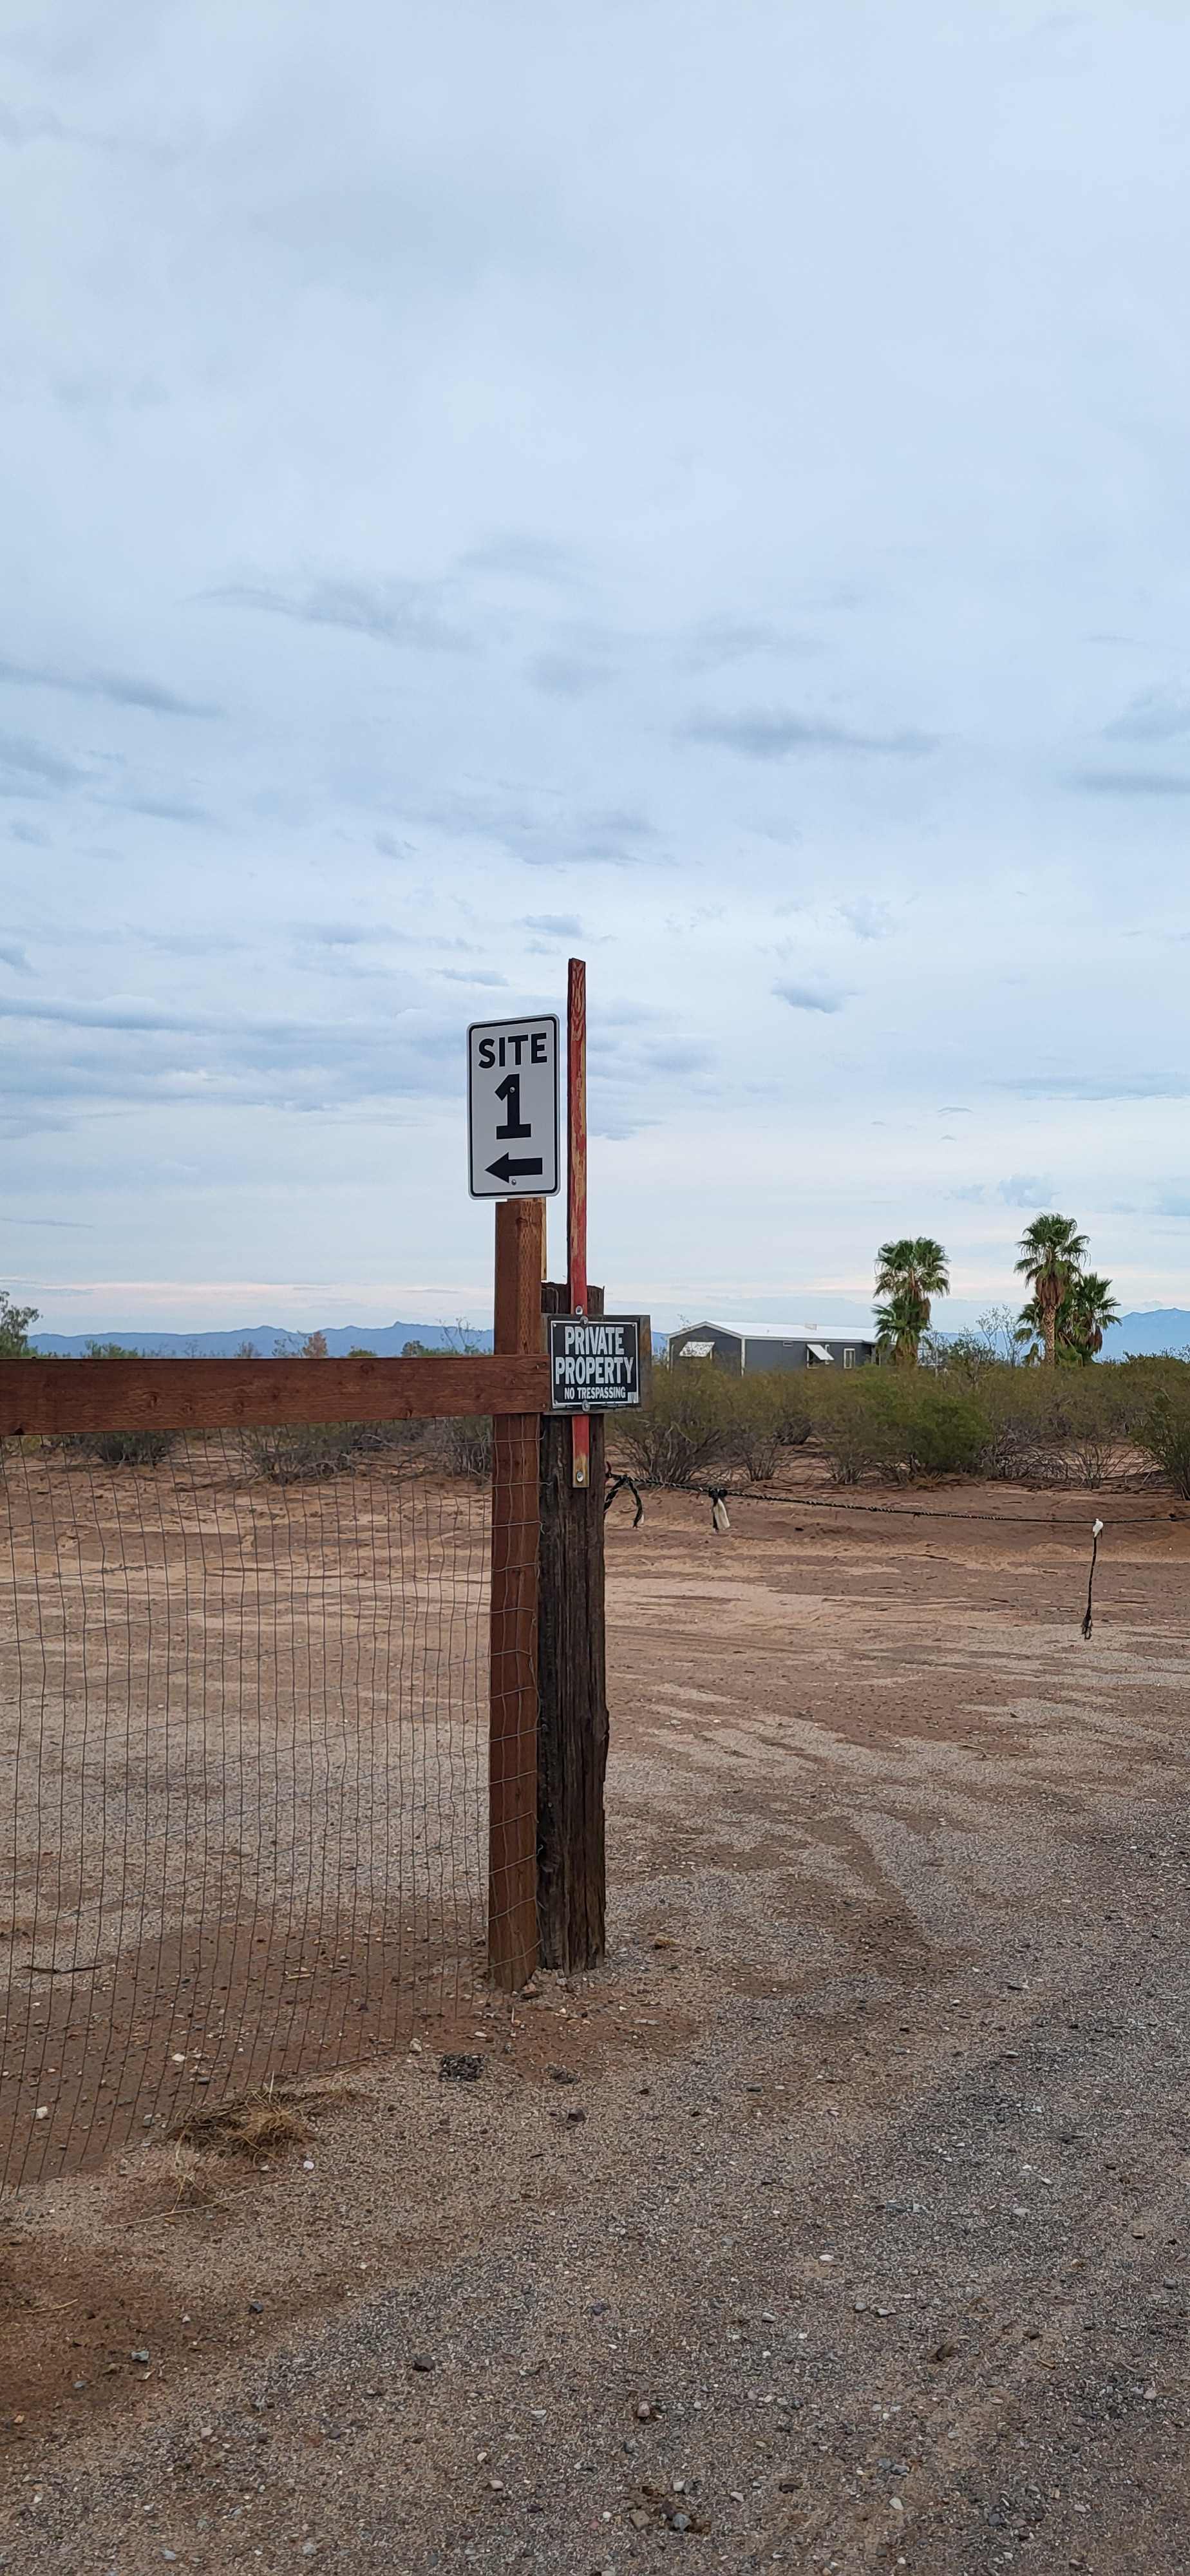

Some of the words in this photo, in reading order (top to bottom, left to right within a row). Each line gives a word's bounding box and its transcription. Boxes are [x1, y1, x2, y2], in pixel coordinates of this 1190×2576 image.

[478, 1032, 547, 1069] SITE
[495, 1074, 531, 1139] 1
[565, 1326, 625, 1355] PRIVATE
[555, 1356, 634, 1385] PROPERTY
[565, 1387, 575, 1399] NO
[577, 1387, 626, 1399] TRESPASSING
